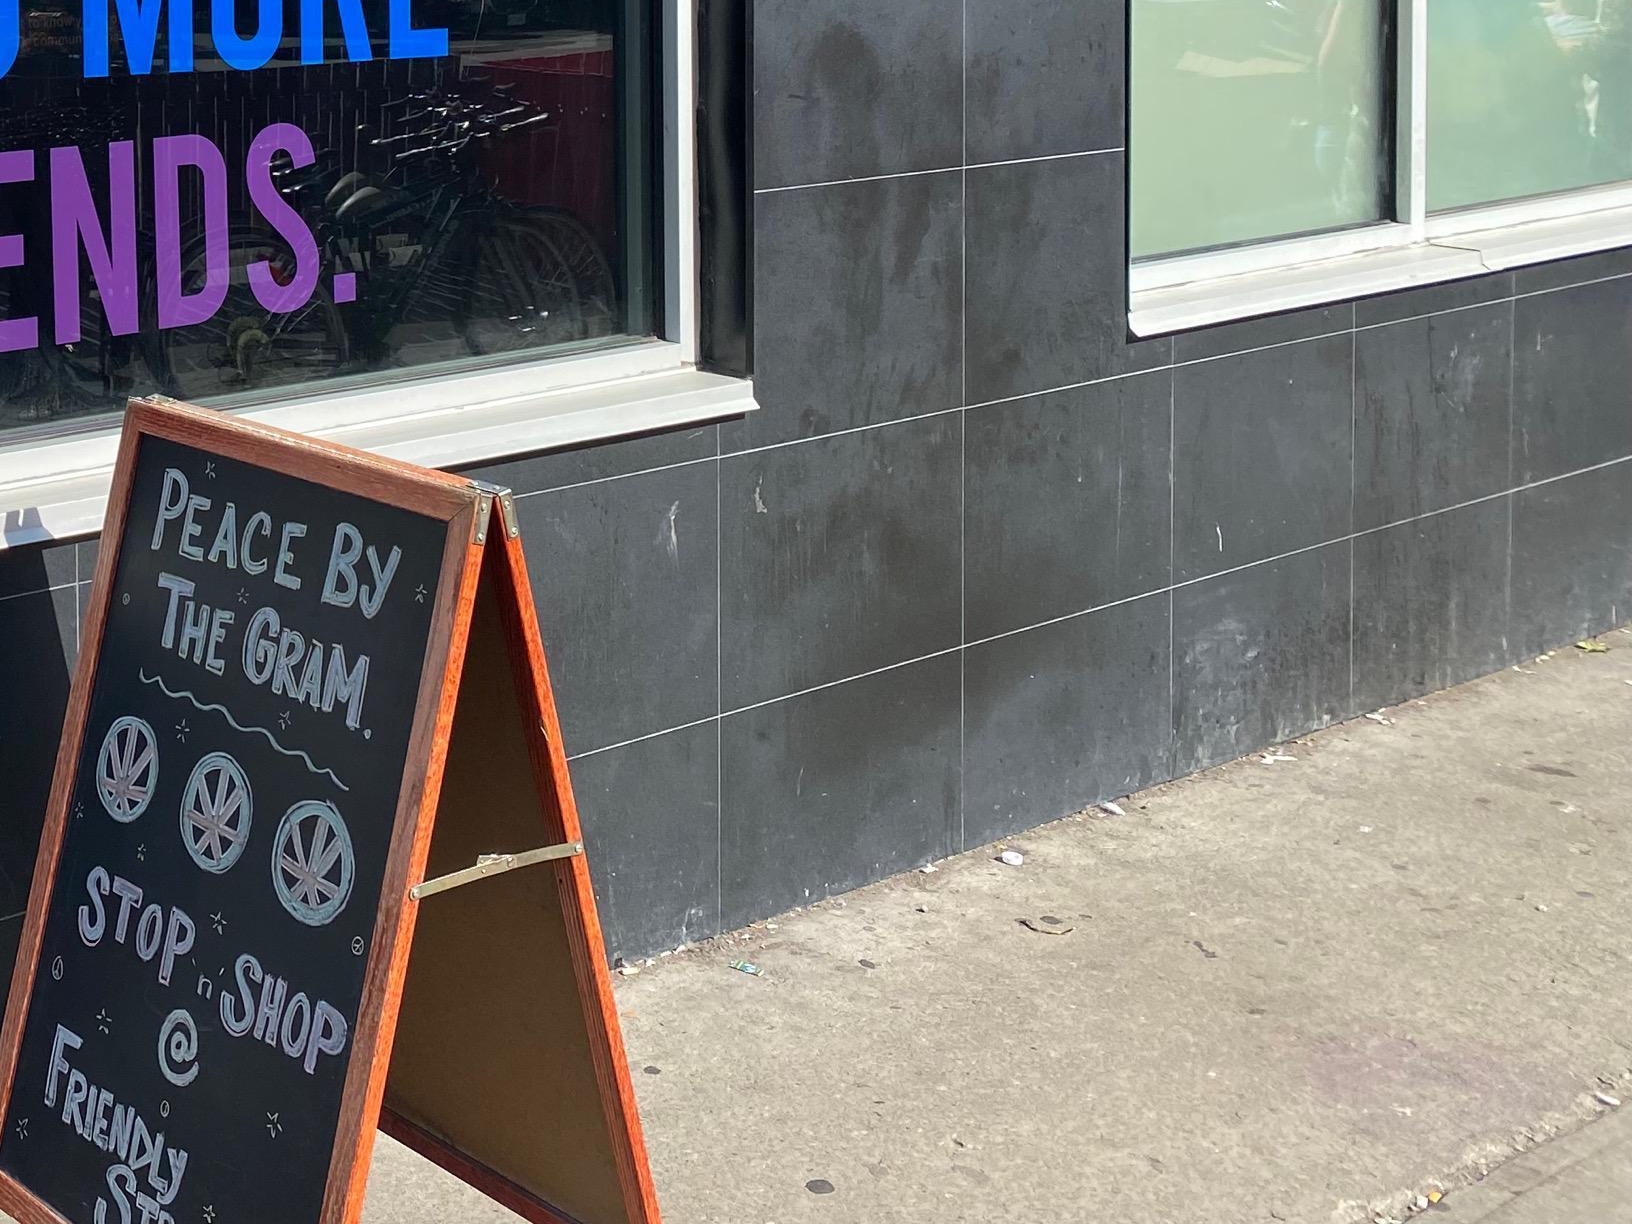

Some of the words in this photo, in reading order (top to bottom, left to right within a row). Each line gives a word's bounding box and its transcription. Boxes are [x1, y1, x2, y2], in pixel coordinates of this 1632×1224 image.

[151, 467, 308, 590] PEACE
[321, 522, 402, 619] BY
[158, 572, 234, 676] THE
[242, 606, 372, 740] GRAM.
[77, 865, 196, 987] STOP
[219, 953, 349, 1075] SHOP
[157, 1008, 200, 1087] @
[44, 1023, 188, 1203] FRIENDLY
